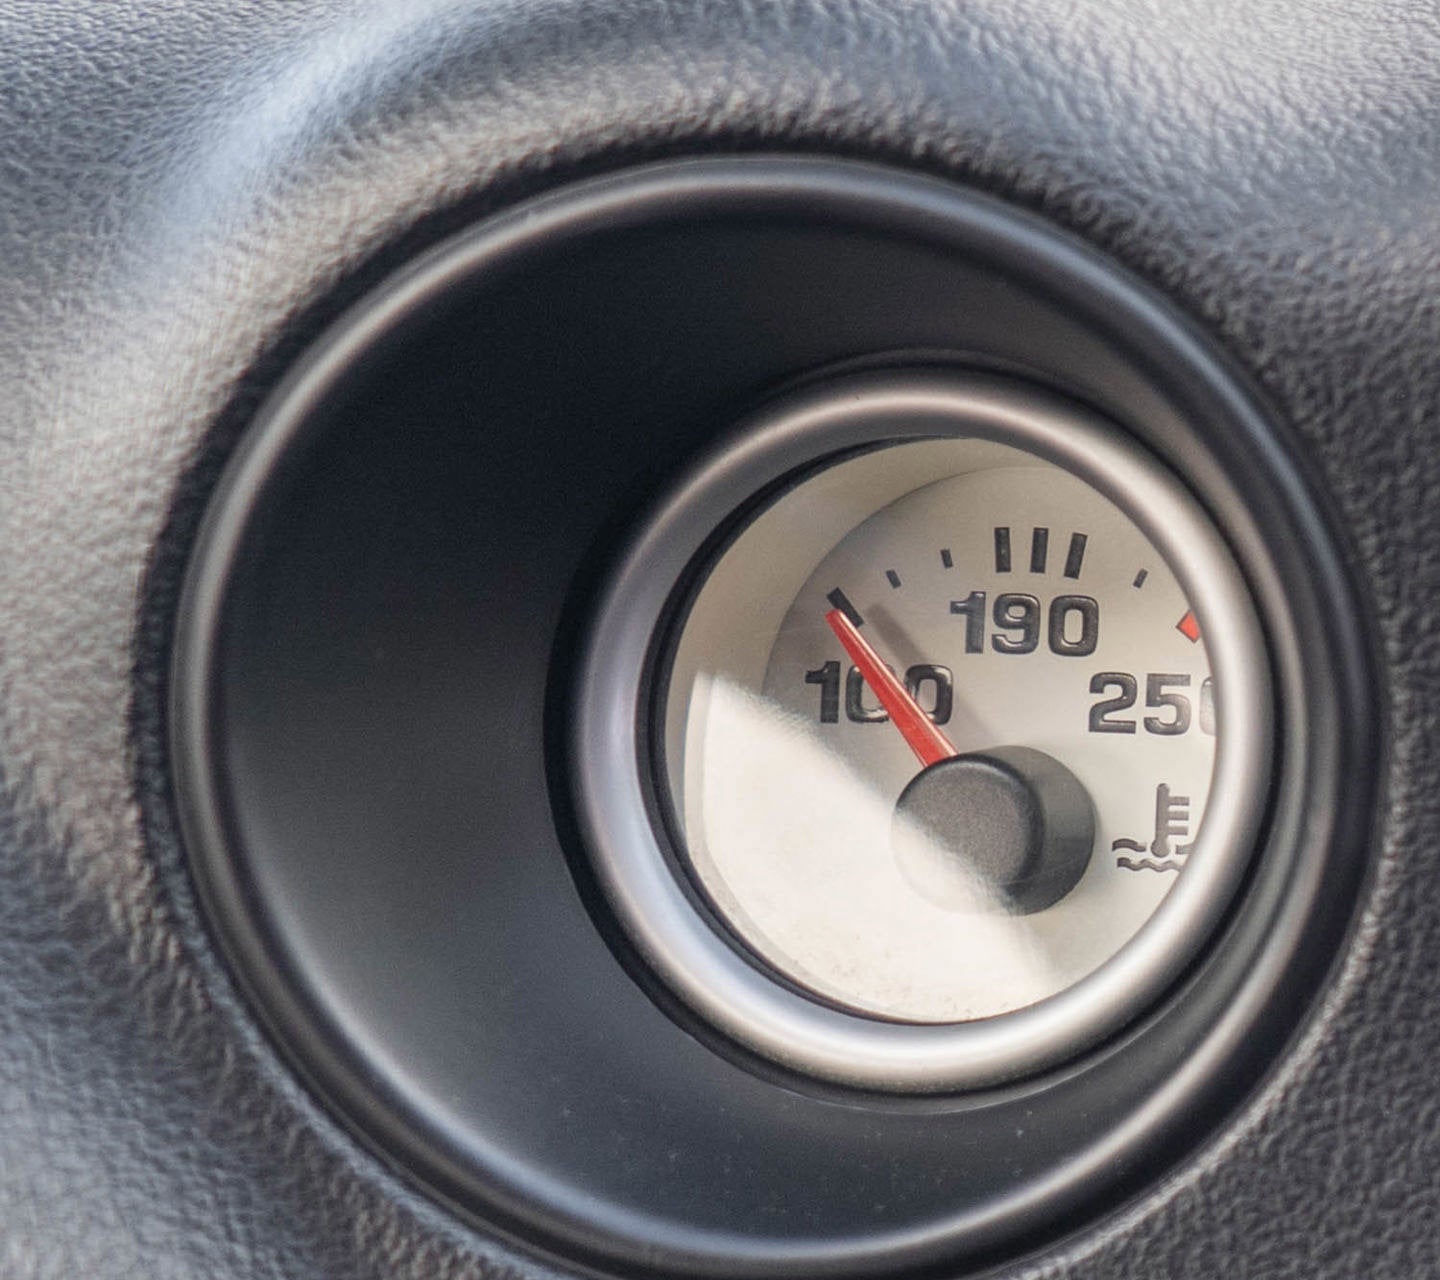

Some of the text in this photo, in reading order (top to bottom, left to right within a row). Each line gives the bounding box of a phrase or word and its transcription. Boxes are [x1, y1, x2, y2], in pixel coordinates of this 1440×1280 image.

[949, 591, 1100, 657] 190
[804, 661, 954, 725] 100
[1088, 671, 1216, 736] 25
